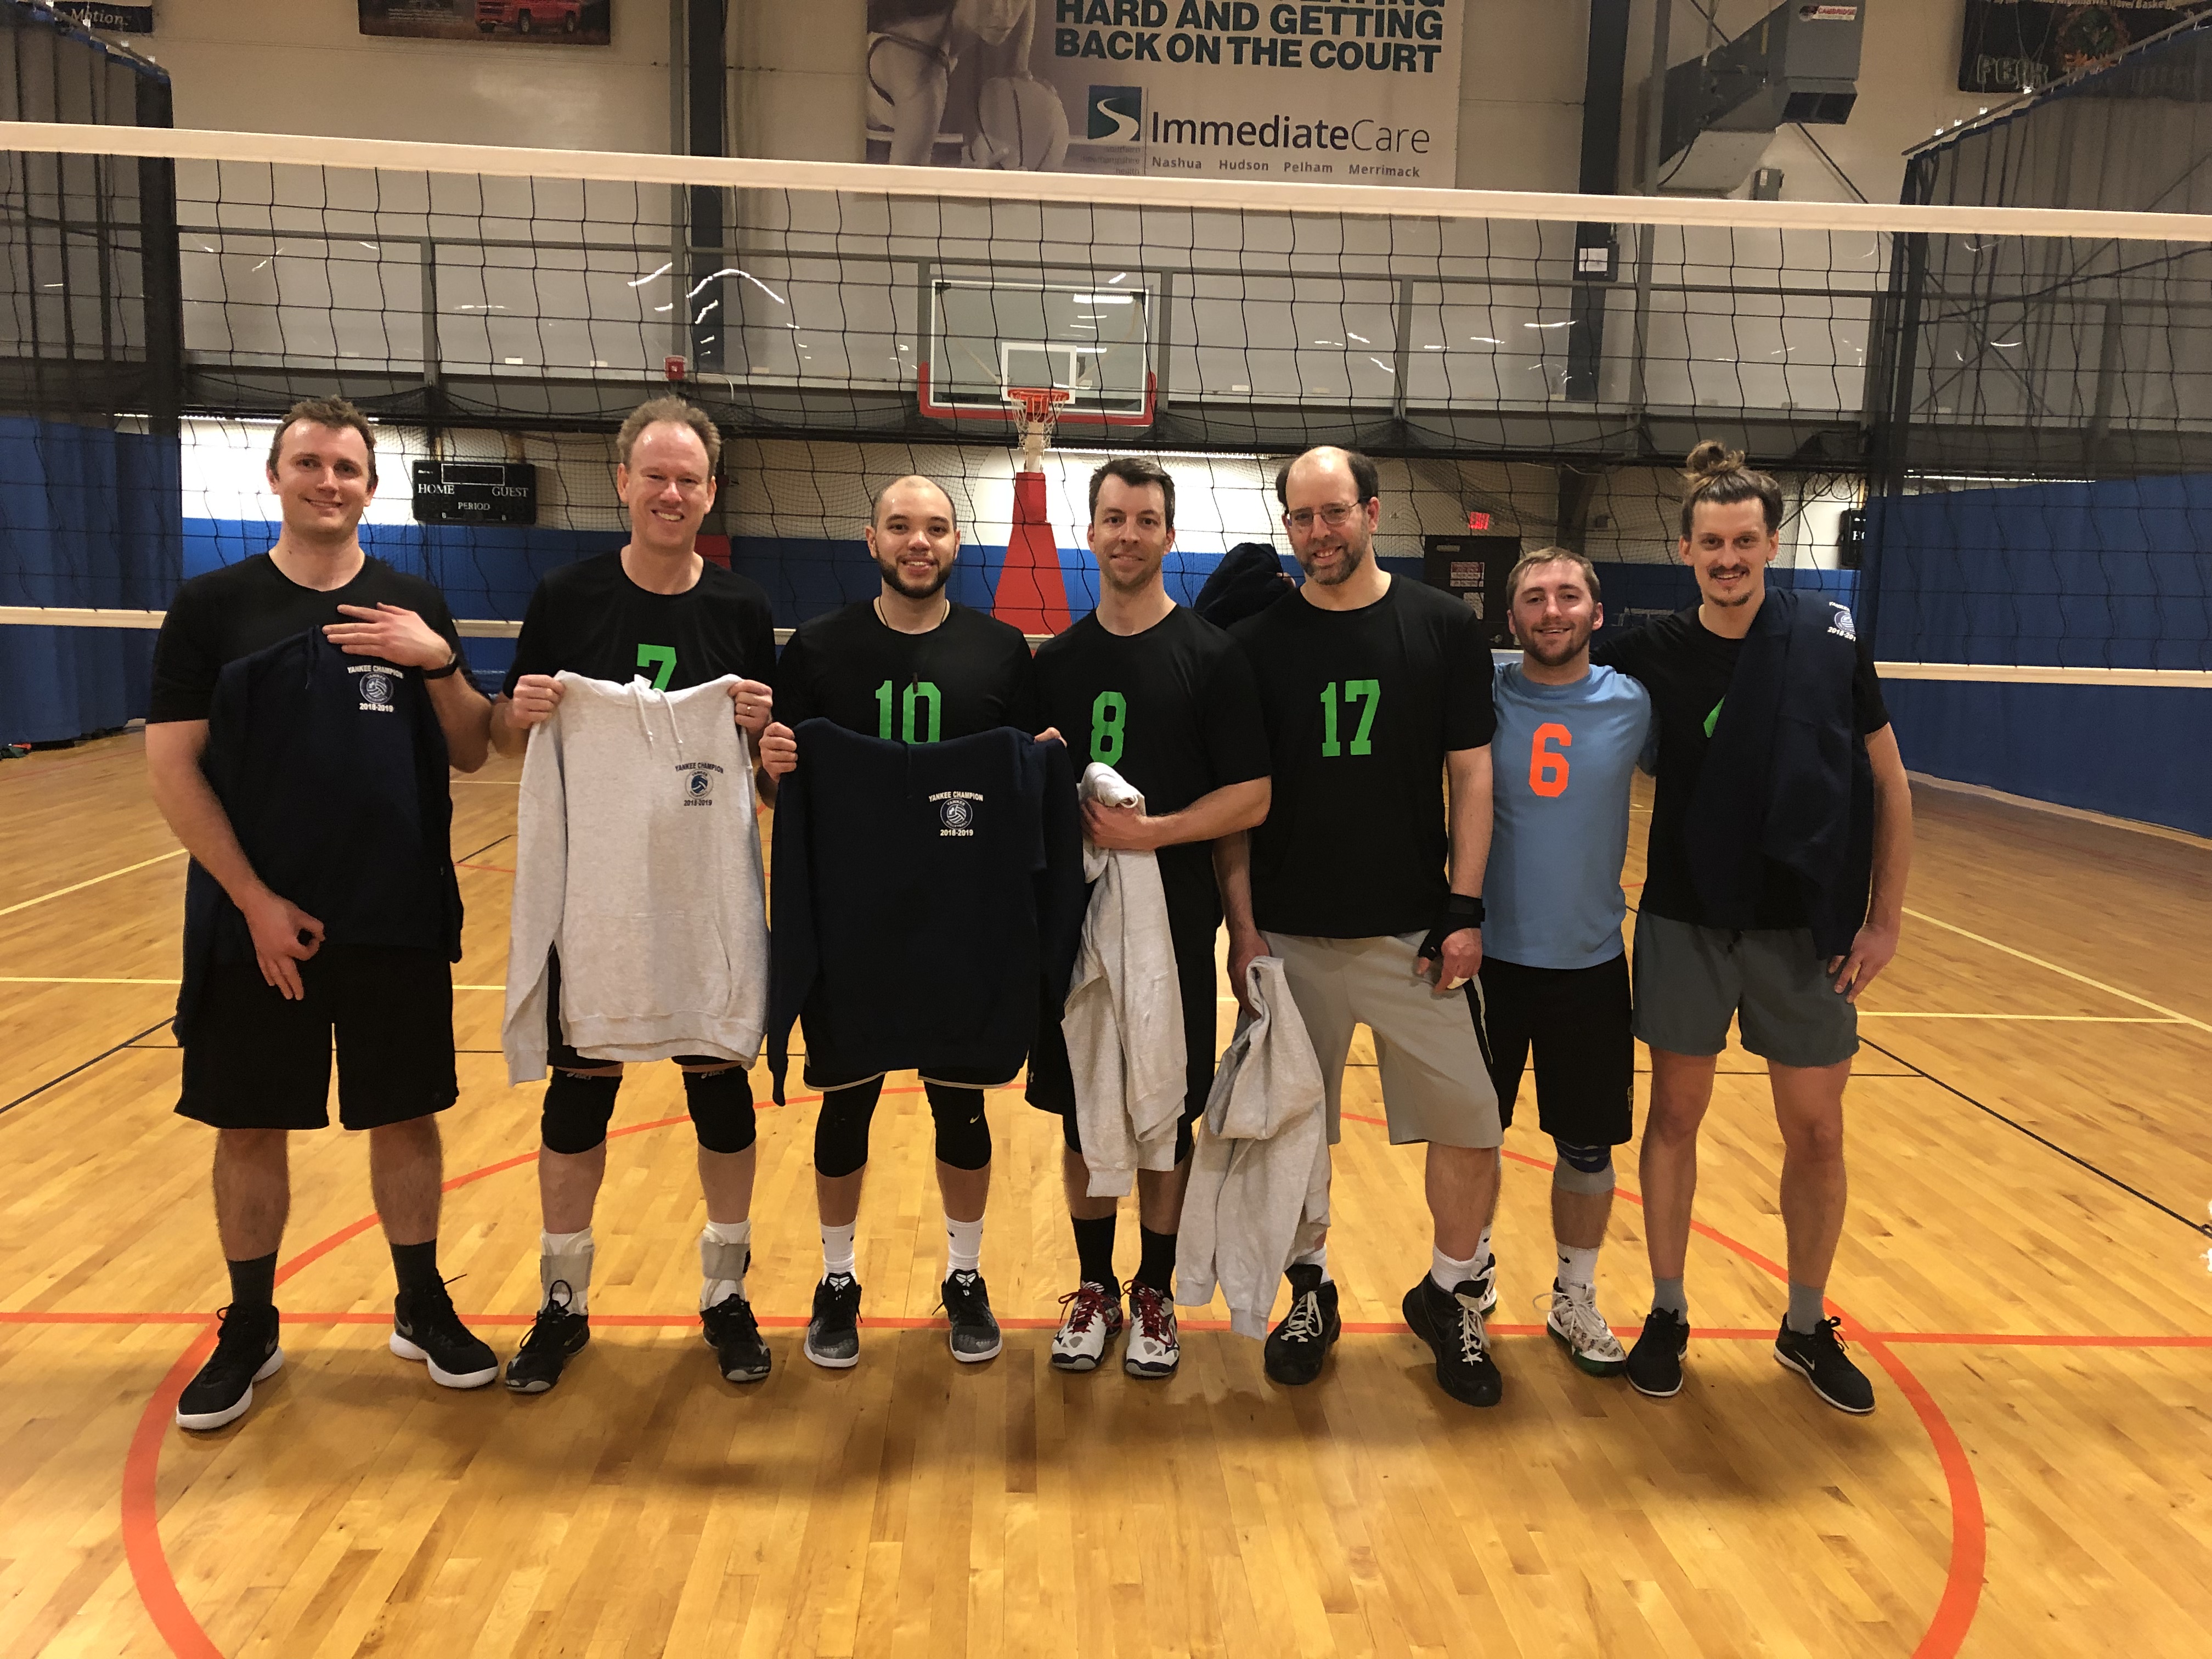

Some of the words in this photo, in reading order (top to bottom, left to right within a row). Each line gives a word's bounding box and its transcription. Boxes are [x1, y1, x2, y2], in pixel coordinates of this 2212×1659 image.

[1056, 0, 1168, 27] HARD
[1175, 0, 1260, 31] AND
[1270, 4, 1443, 41] GETTING
[1055, 28, 1161, 61] BACK
[1166, 33, 1221, 65] ON
[1227, 36, 1302, 67] THE
[1310, 40, 1442, 72] COURT
[1153, 111, 1430, 154] ImmediateCare
[1153, 156, 1202, 169] Nashua
[1219, 159, 1269, 171] Hudson
[1284, 162, 1333, 174] Pelham
[1349, 164, 1420, 178] Merrimack
[418, 483, 455, 494] HOME
[492, 486, 529, 498] GUEST
[458, 501, 490, 511] PERIOD
[347, 664, 372, 674] YANKEE
[373, 665, 404, 679] CHAMPION
[636, 644, 678, 692] 7
[359, 702, 394, 713] 2018-2019
[876, 680, 941, 745] 10
[1320, 679, 1381, 757] 17
[1090, 691, 1127, 768] 8
[675, 763, 696, 772] YANKEE
[697, 762, 724, 774] CHAMPION
[1528, 722, 1573, 798] 6
[928, 791, 952, 803] YANKEE
[953, 791, 984, 802] CHAMPION
